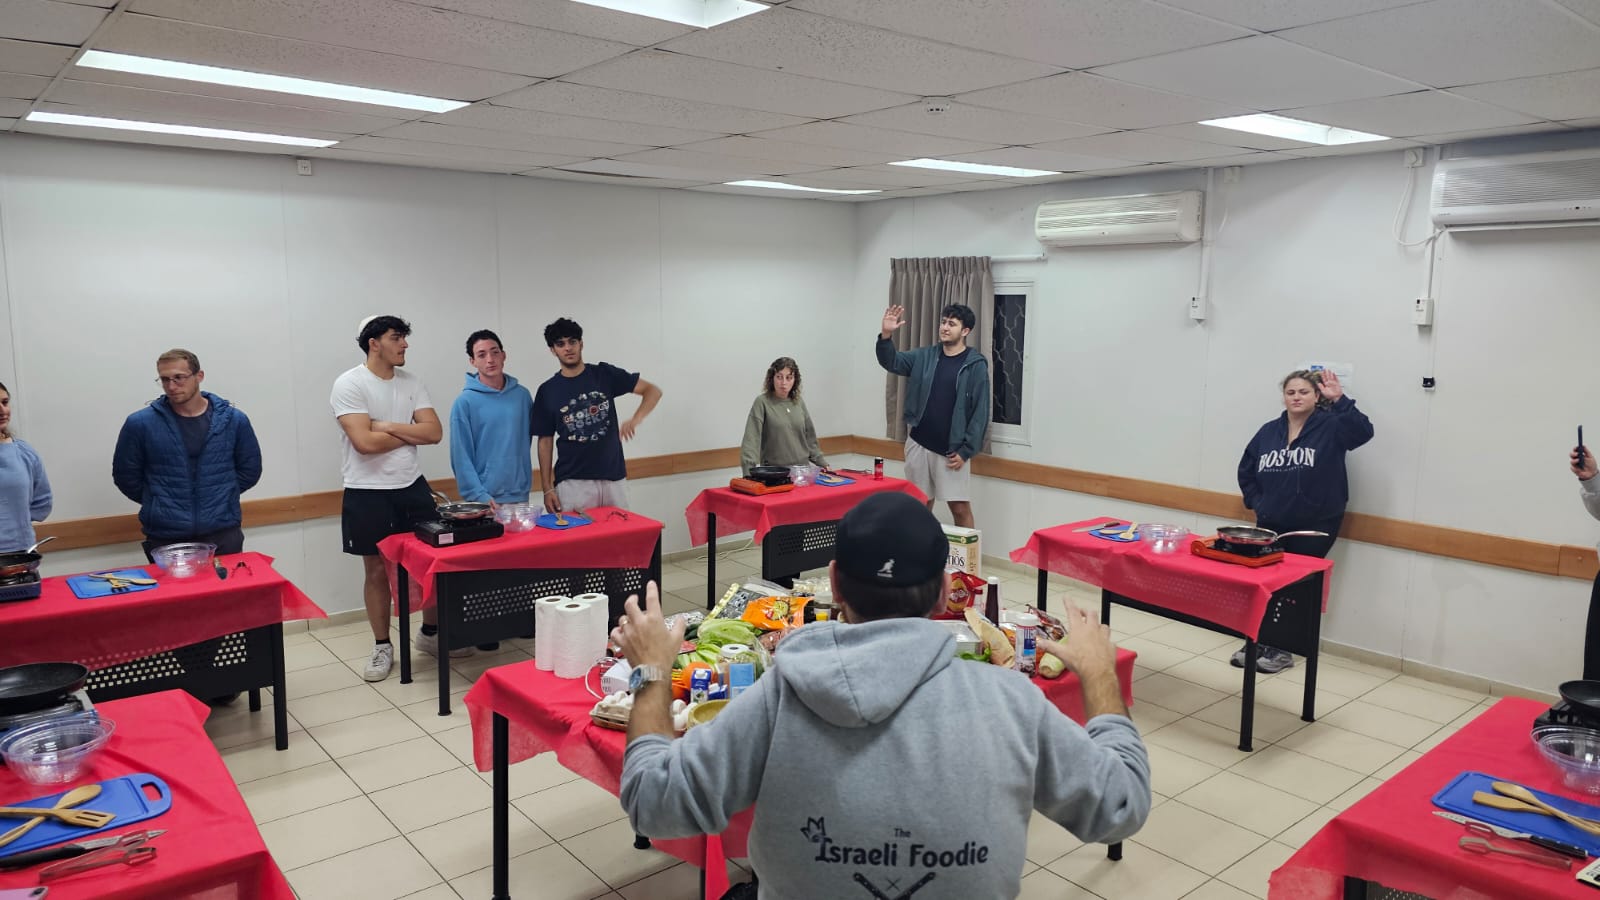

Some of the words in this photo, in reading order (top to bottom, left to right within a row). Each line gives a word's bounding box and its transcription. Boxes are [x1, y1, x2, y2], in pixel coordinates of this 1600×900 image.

[1257, 446, 1316, 473] BOSTON
[894, 828, 911, 838] The
[814, 836, 897, 867] Israeli
[909, 842, 989, 868] Foodie
